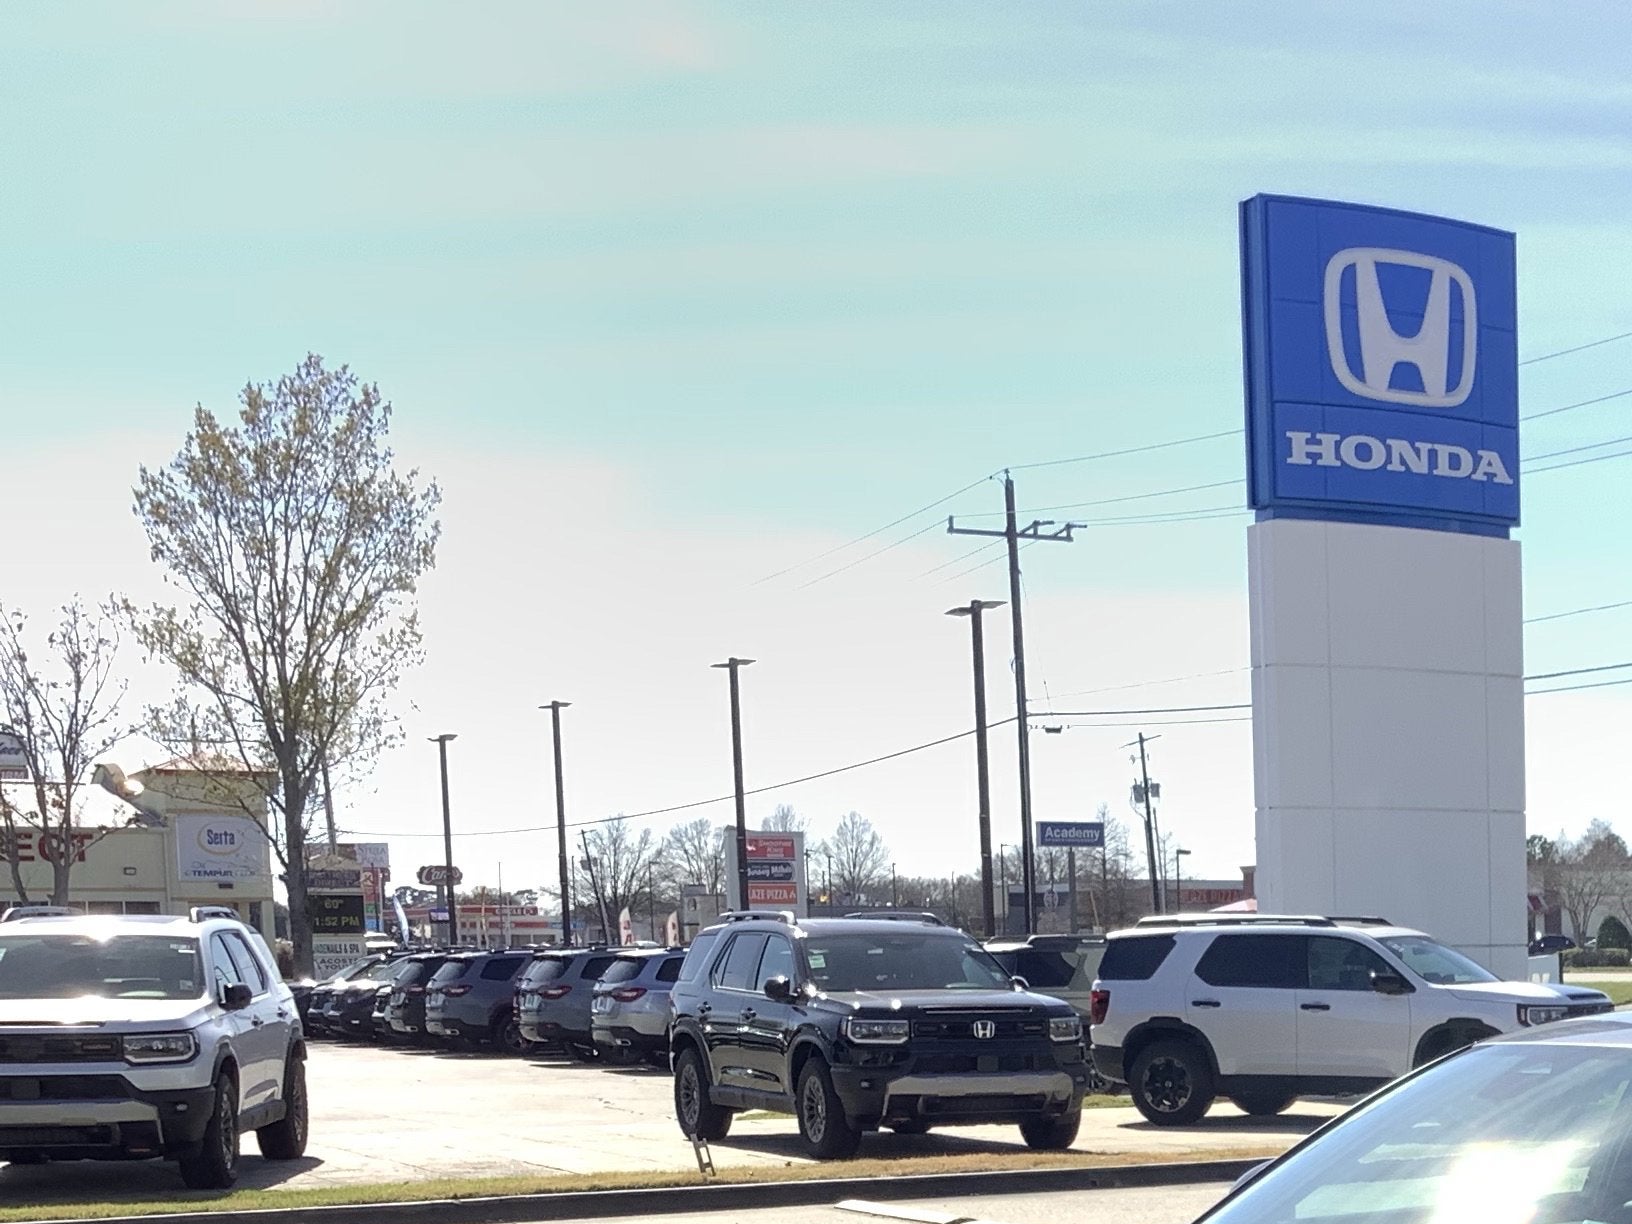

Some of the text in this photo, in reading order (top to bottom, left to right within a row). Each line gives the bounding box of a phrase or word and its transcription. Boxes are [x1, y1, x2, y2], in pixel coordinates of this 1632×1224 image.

[1286, 431, 1513, 485] HONDA
[207, 829, 235, 845] Serta
[1044, 826, 1100, 841] Academy
[341, 916, 360, 926] PM
[349, 943, 360, 954] SPA
